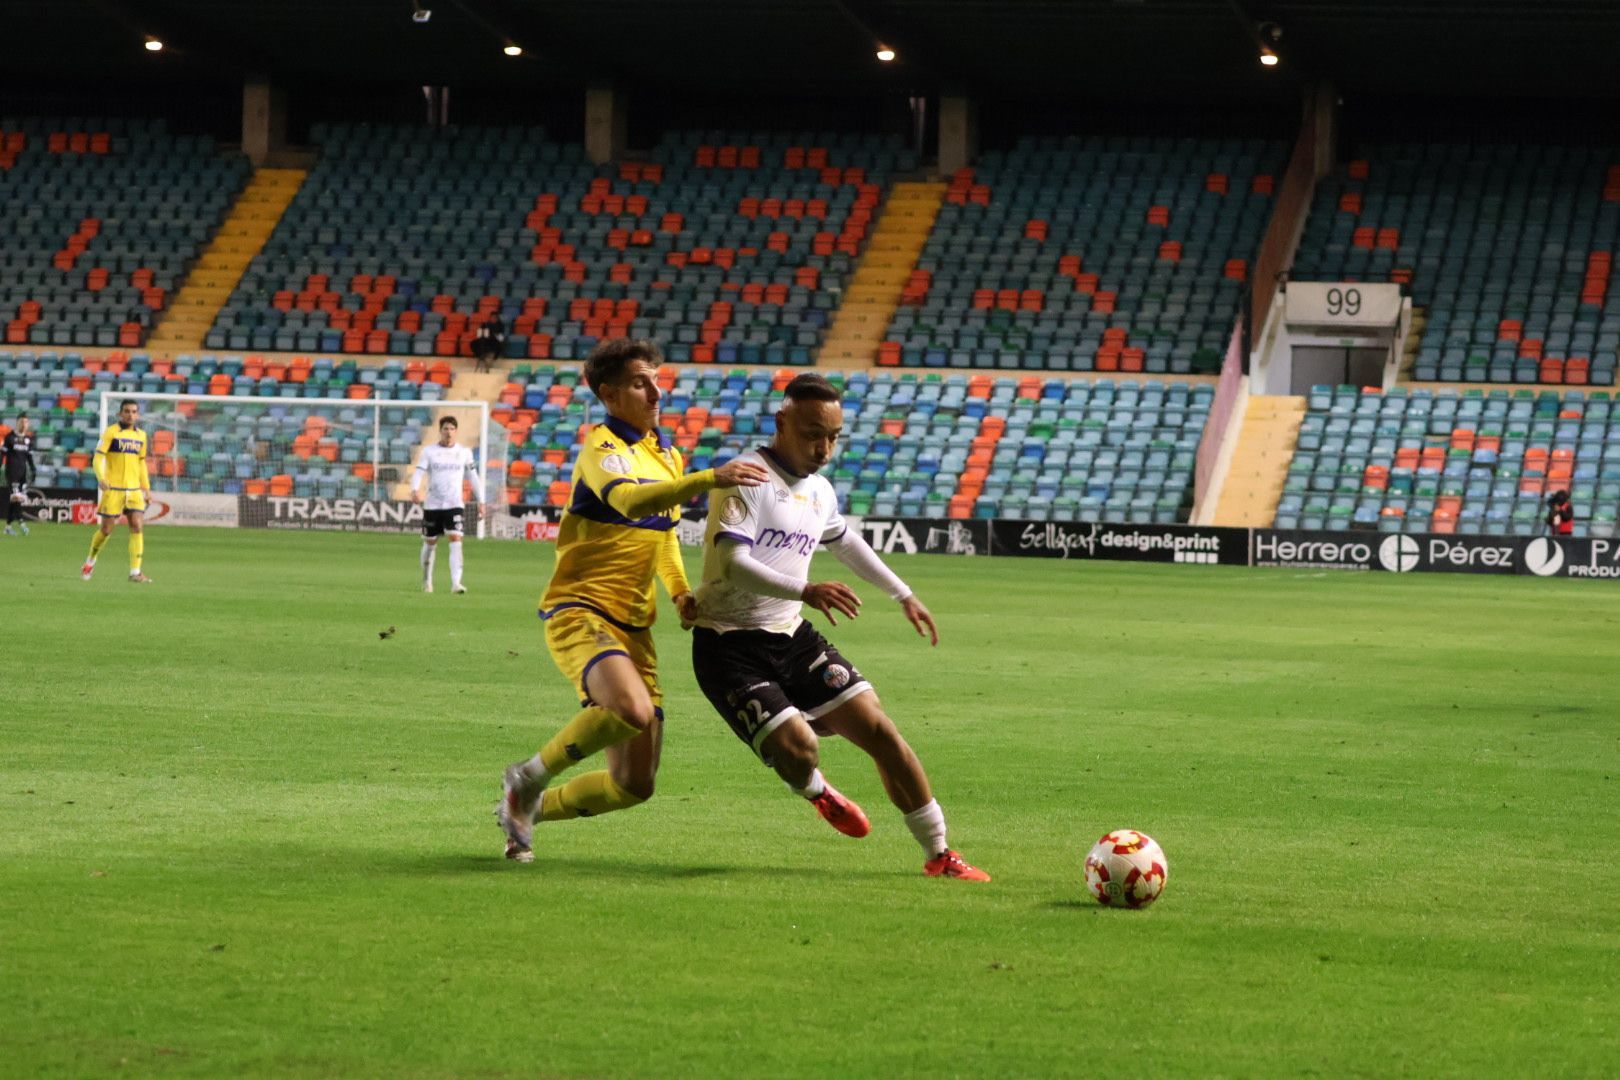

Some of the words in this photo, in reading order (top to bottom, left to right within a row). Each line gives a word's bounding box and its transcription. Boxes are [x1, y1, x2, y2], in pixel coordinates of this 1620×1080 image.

[1326, 288, 1362, 316] 99
[38, 505, 53, 520] el
[57, 505, 73, 523] pi
[266, 497, 424, 523] TRASANA
[861, 521, 917, 554] TA
[1101, 530, 1219, 552] design&print
[1256, 534, 1371, 562] Herrero
[1429, 539, 1513, 567] Pérez
[1568, 564, 1620, 577] PRODU
[737, 699, 770, 734] 22
